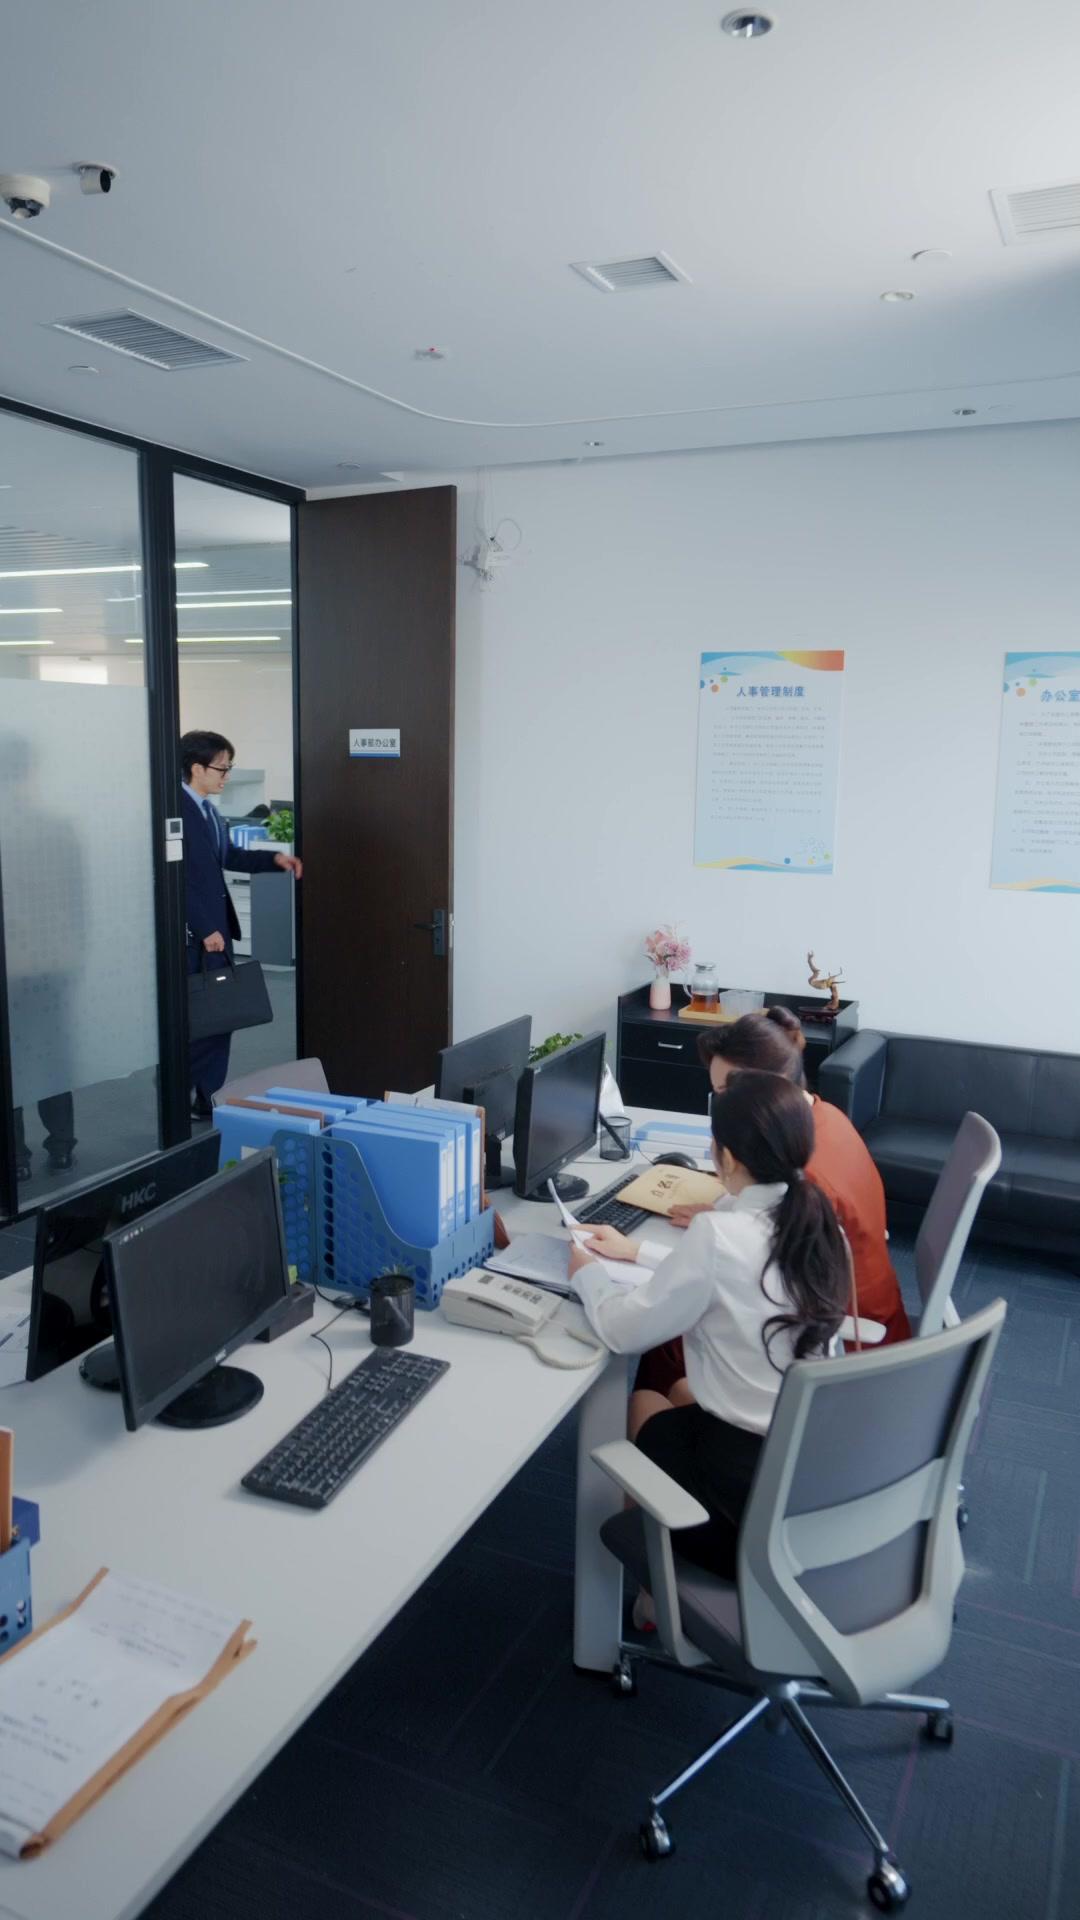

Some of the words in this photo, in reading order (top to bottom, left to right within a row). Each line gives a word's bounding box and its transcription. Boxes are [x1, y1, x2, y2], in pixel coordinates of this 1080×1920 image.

[736, 685, 806, 698] 人事管理制度
[121, 1182, 157, 1213] HKC
